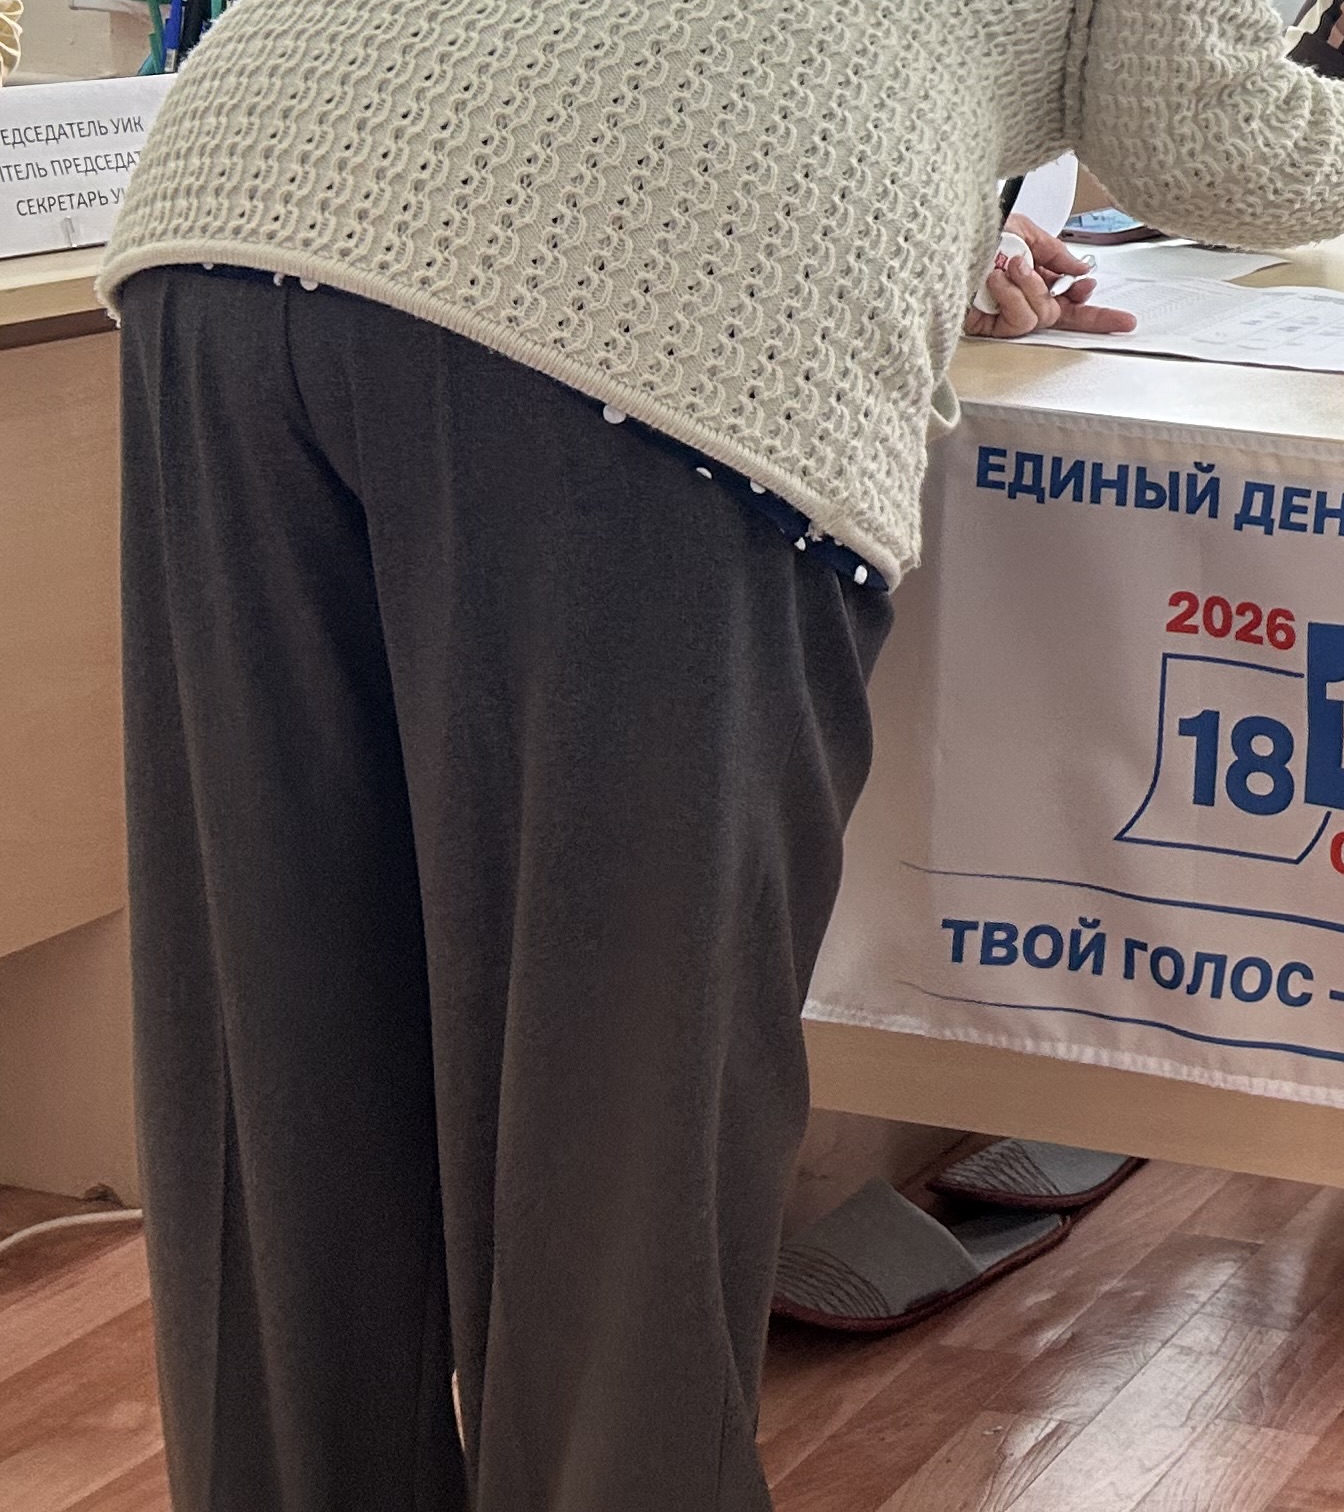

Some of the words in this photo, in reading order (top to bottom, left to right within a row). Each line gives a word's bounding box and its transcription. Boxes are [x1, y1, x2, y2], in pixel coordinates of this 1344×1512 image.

[110, 116, 144, 134] УИК
[16, 190, 108, 216] СЕКРЕТАРЬ
[976, 446, 1221, 520] ЕДИНЫЙ
[1165, 591, 1297, 651] 2026
[1177, 709, 1295, 816] 18
[941, 916, 1106, 976] ТВОЙ
[1123, 937, 1314, 1008] ГОЛОС
